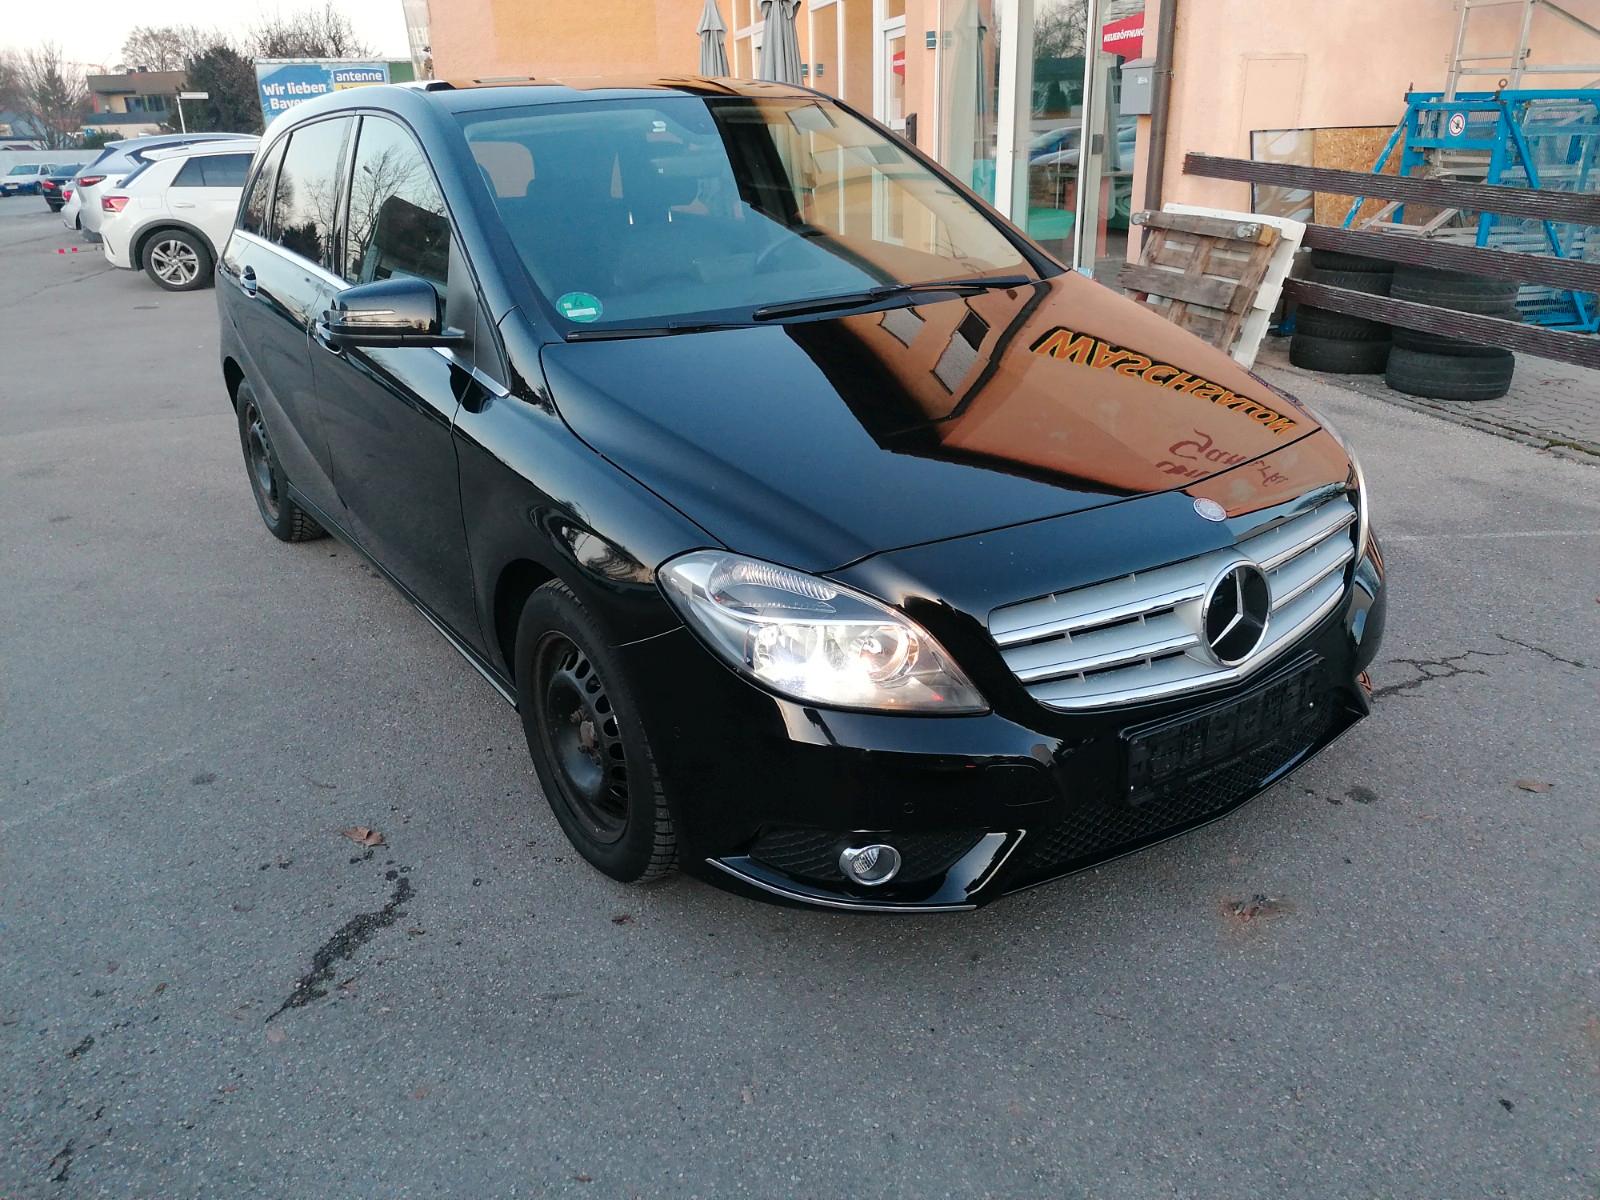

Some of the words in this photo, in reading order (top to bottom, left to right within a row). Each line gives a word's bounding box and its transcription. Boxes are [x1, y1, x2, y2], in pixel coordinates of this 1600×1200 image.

[336, 71, 383, 82] antenne
[262, 82, 286, 96] Wir
[286, 81, 327, 95] lieben
[270, 97, 304, 110] Baye
